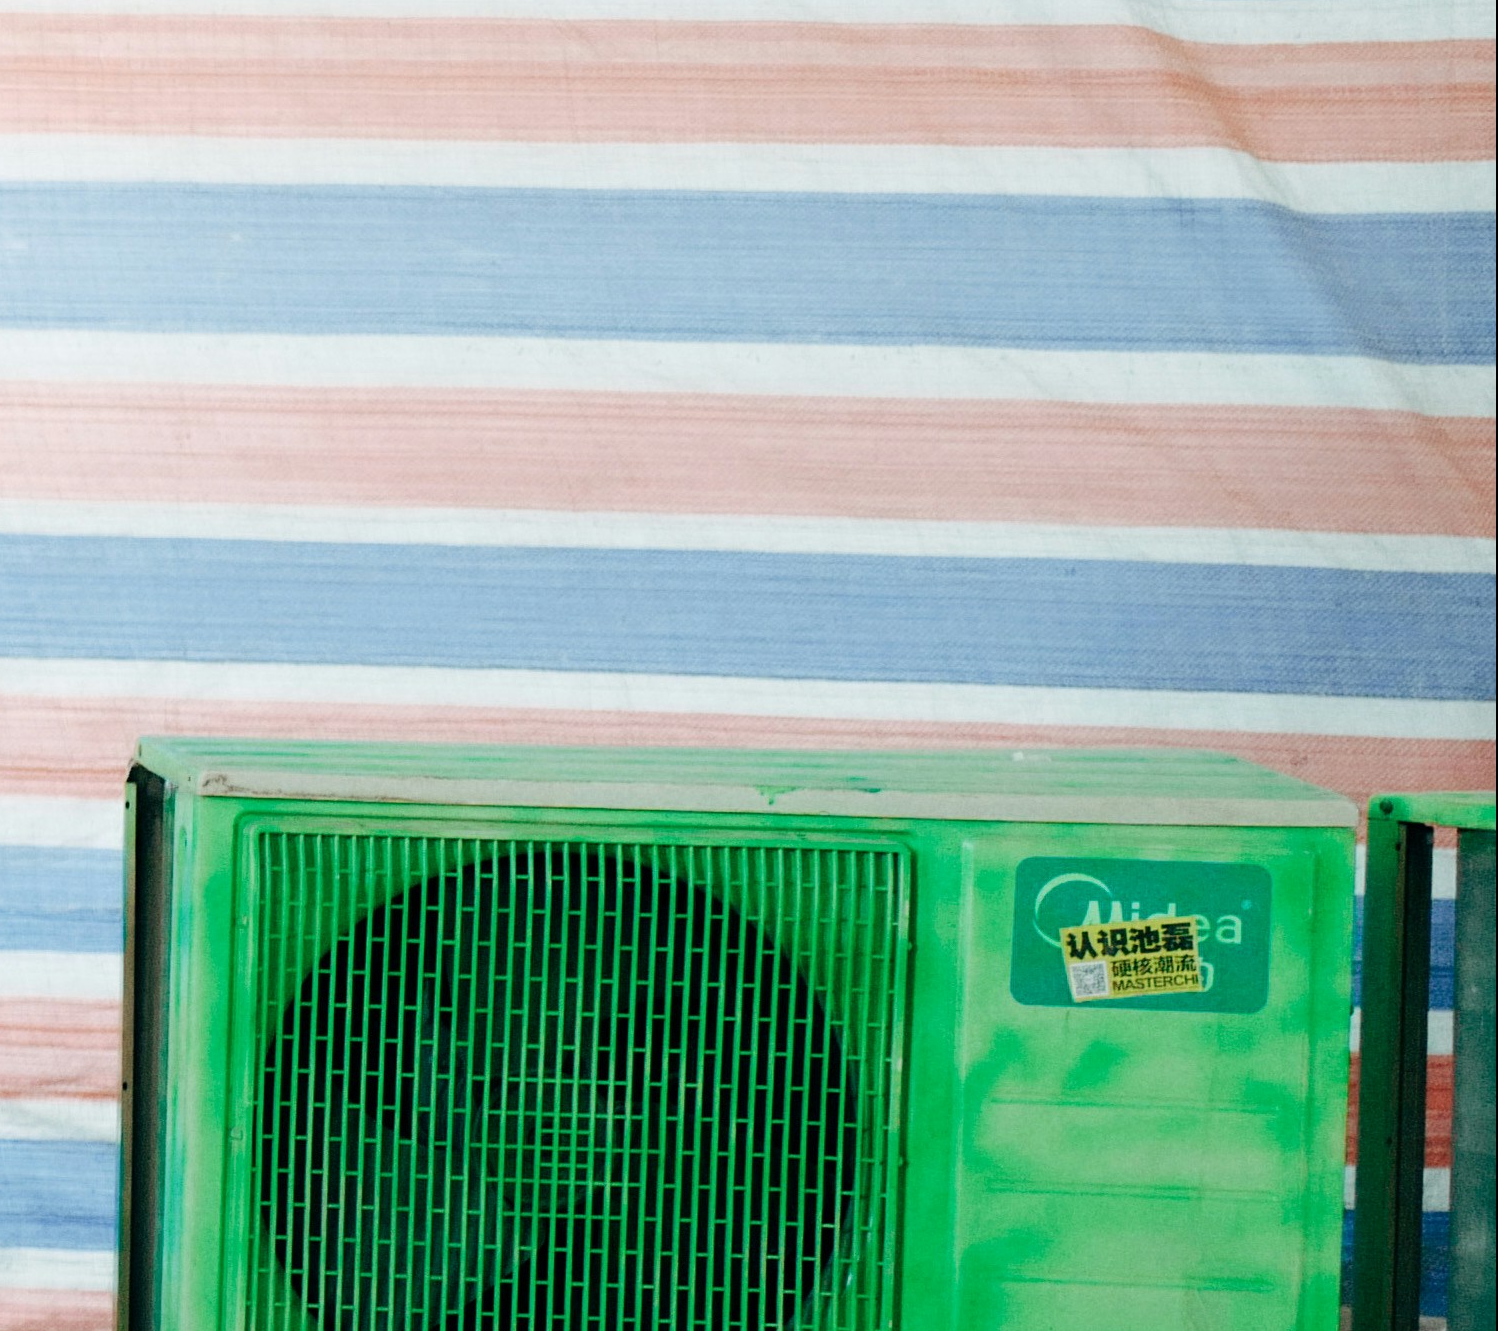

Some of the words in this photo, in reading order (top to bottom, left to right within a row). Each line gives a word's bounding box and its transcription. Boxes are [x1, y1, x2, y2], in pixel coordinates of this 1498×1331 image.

[1066, 921, 1195, 960] 认识池磊
[1111, 954, 1198, 979] 硬核潮流
[1111, 974, 1199, 992] MASTERCHI
